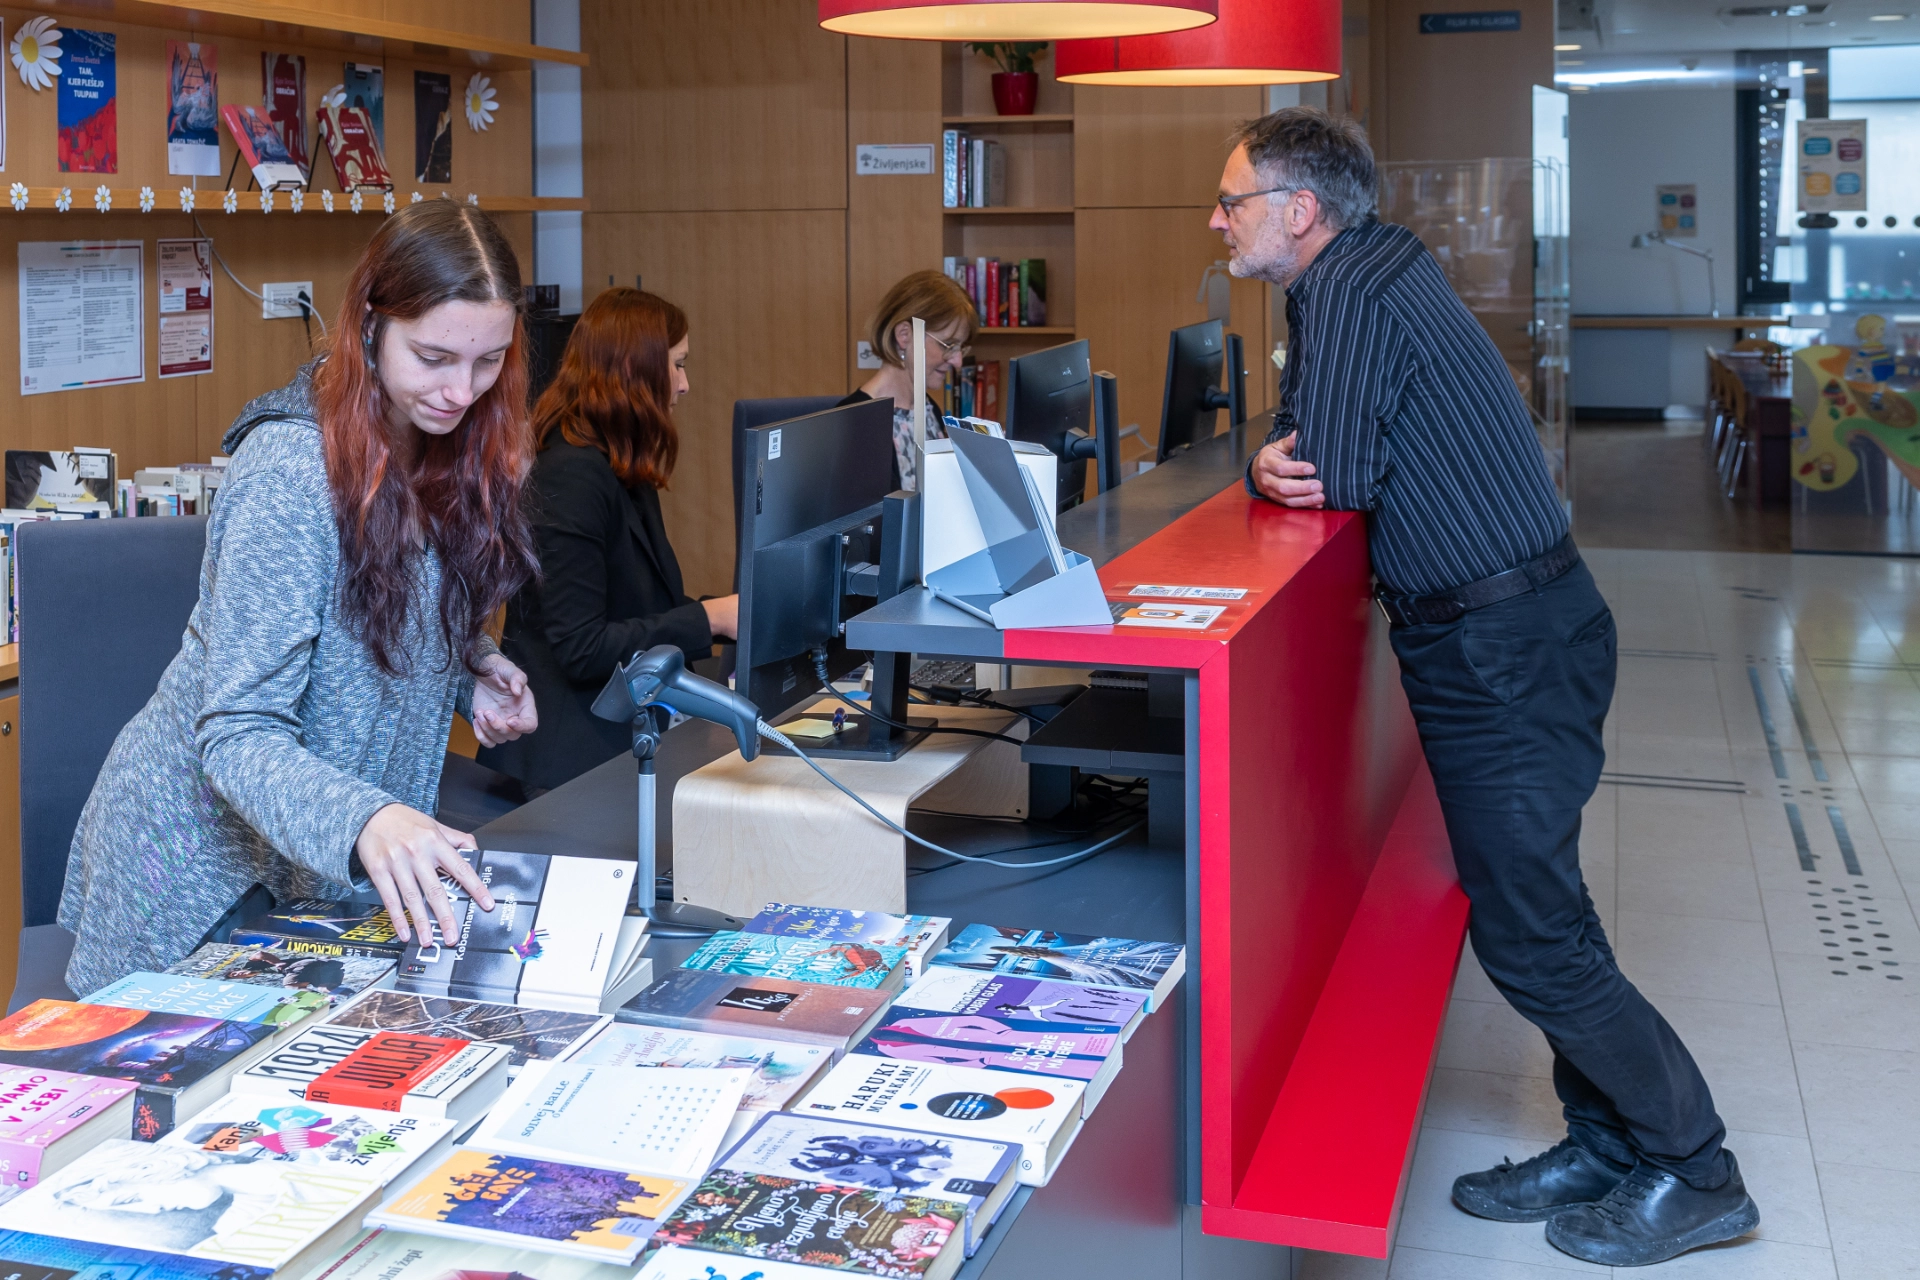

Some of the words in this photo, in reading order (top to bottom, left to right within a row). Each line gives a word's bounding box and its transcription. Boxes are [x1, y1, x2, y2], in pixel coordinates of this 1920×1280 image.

[68, 78, 81, 86] KJER
[82, 77, 104, 88] PLEŠEJO
[78, 66, 94, 76] TAM,
[74, 90, 99, 99] TULIPANI
[872, 156, 926, 171] Življenjske
[286, 940, 343, 956] MERCURY
[741, 950, 777, 965] NE
[806, 954, 842, 972] ME
[982, 982, 1004, 1001] GLAS
[259, 1030, 379, 1083] 1984
[1004, 1041, 1034, 1062] ŠOLA
[1030, 1034, 1060, 1062] DOBRE
[1045, 1040, 1076, 1070] MATERE
[334, 1038, 446, 1090] JULIJA
[417, 1068, 448, 1093] SANDRA
[445, 1047, 478, 1073] NEWMAN
[1022, 1061, 1043, 1071] ZA
[842, 1062, 900, 1110] HARUKI
[866, 1065, 918, 1113] MURAKAMI
[21, 1088, 69, 1112] SEBI
[347, 1118, 418, 1166] življenja
[480, 1168, 537, 1200] FAYE
[733, 1196, 793, 1232] Njeno
[780, 1193, 836, 1248] izgubljeno
